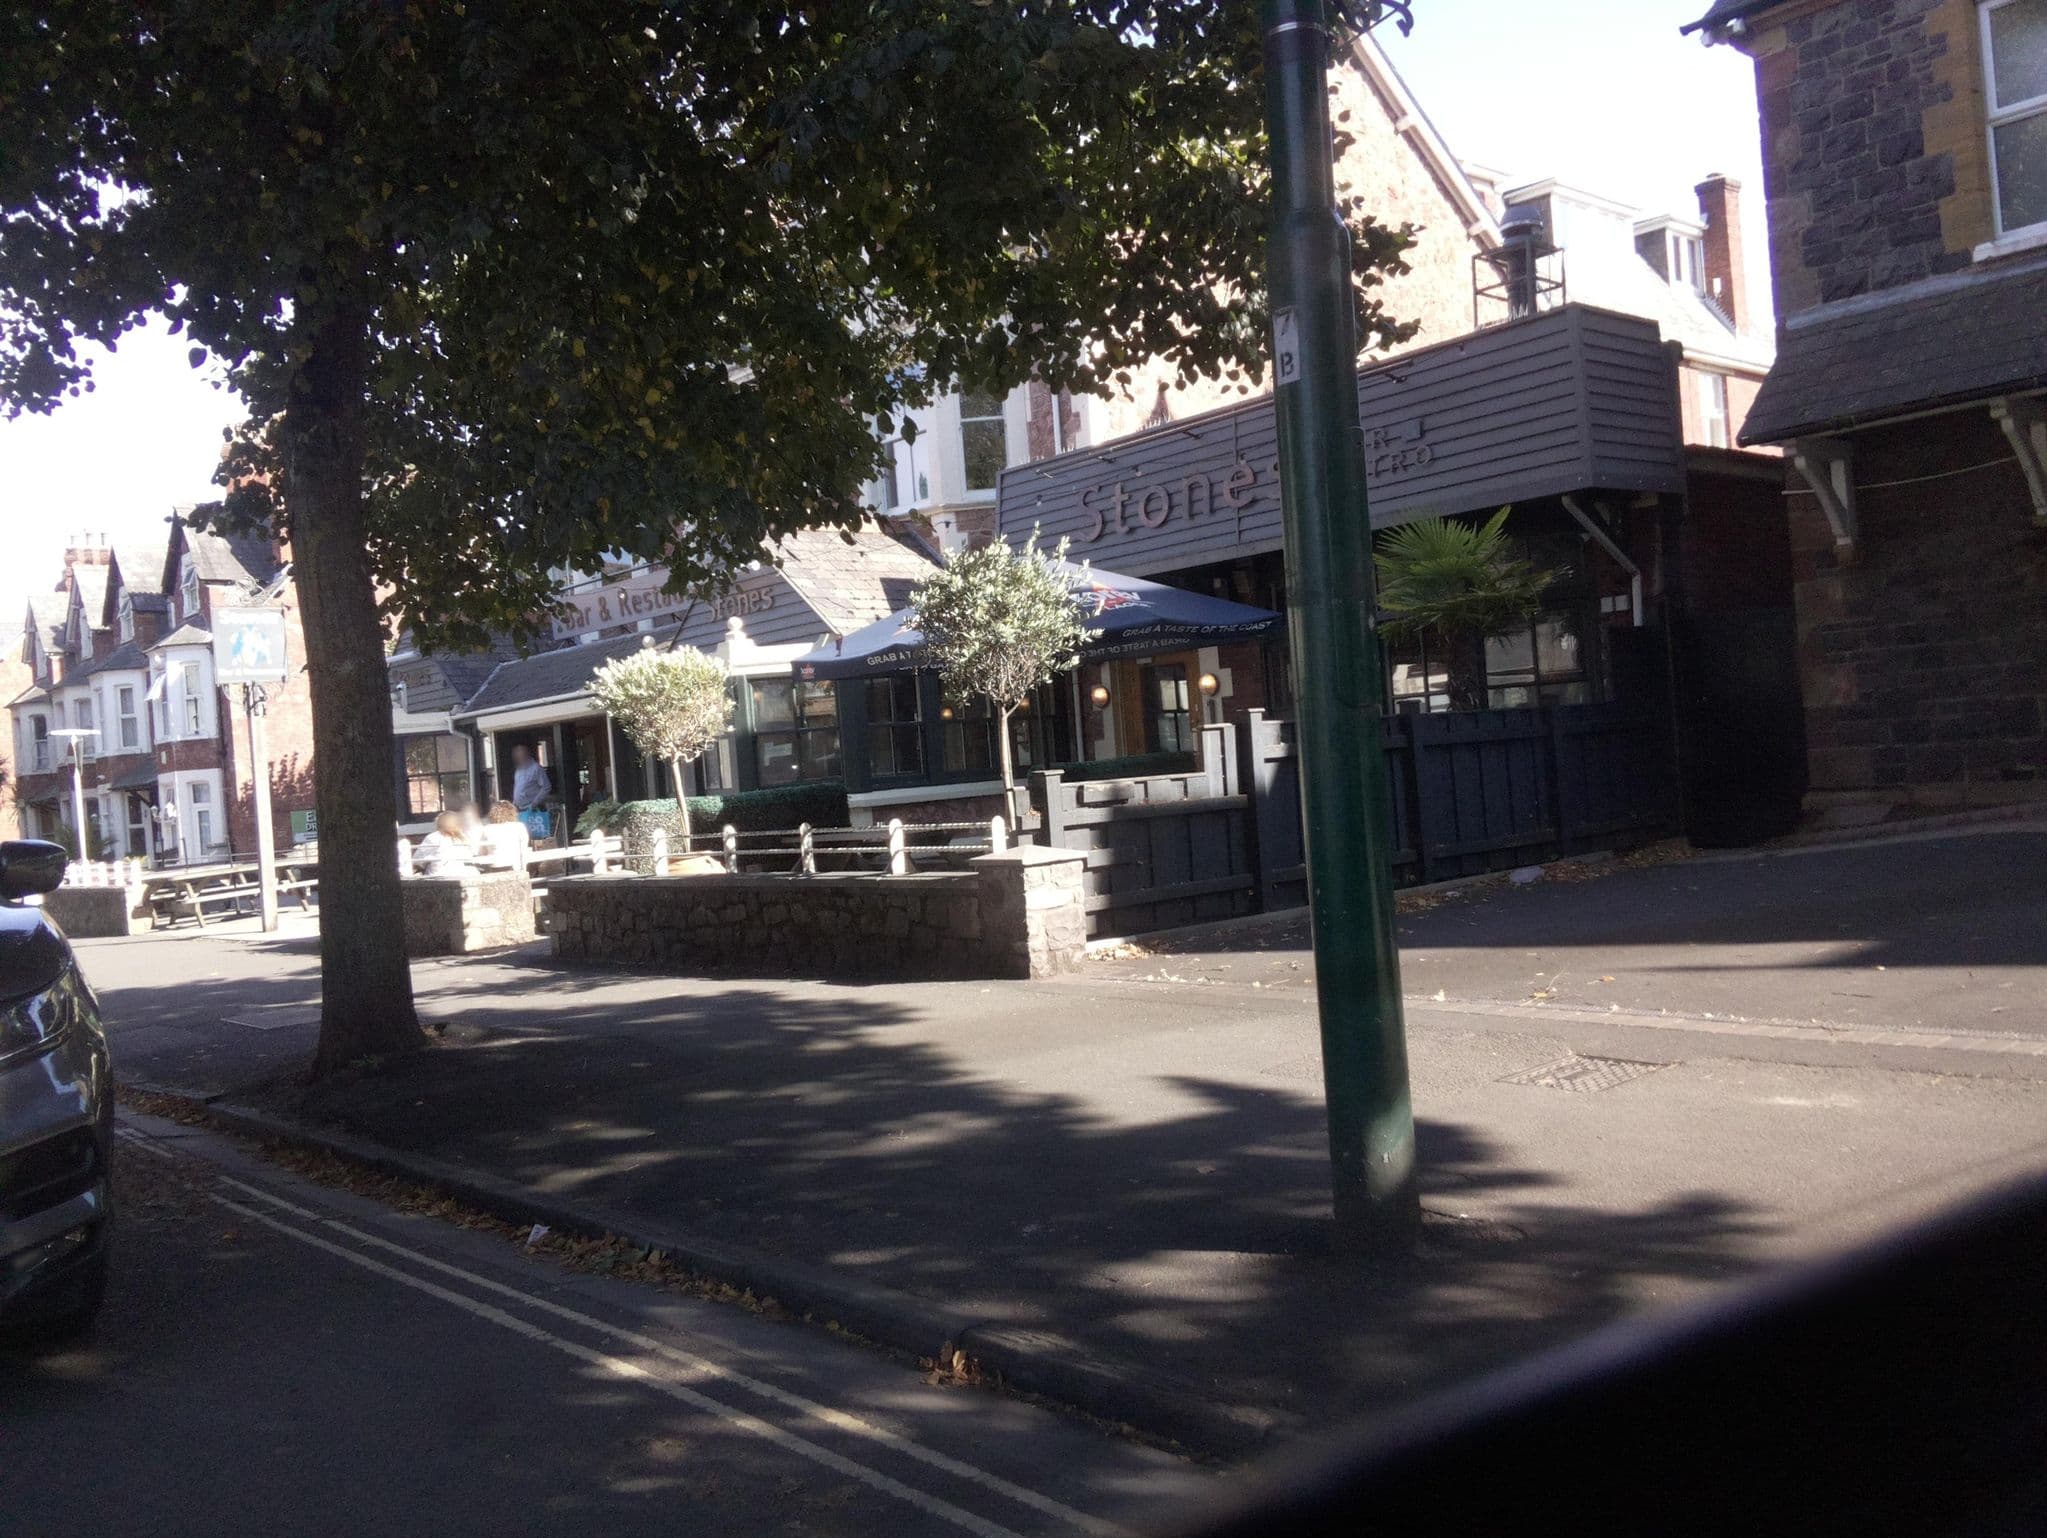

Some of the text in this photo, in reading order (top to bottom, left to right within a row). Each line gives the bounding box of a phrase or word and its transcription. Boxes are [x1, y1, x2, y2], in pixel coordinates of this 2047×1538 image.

[1077, 462, 1282, 543] Stone
[597, 595, 612, 622] &
[1121, 621, 1273, 638] GRAB A TASTE OF THE COAST
[866, 652, 898, 666] GRAB
